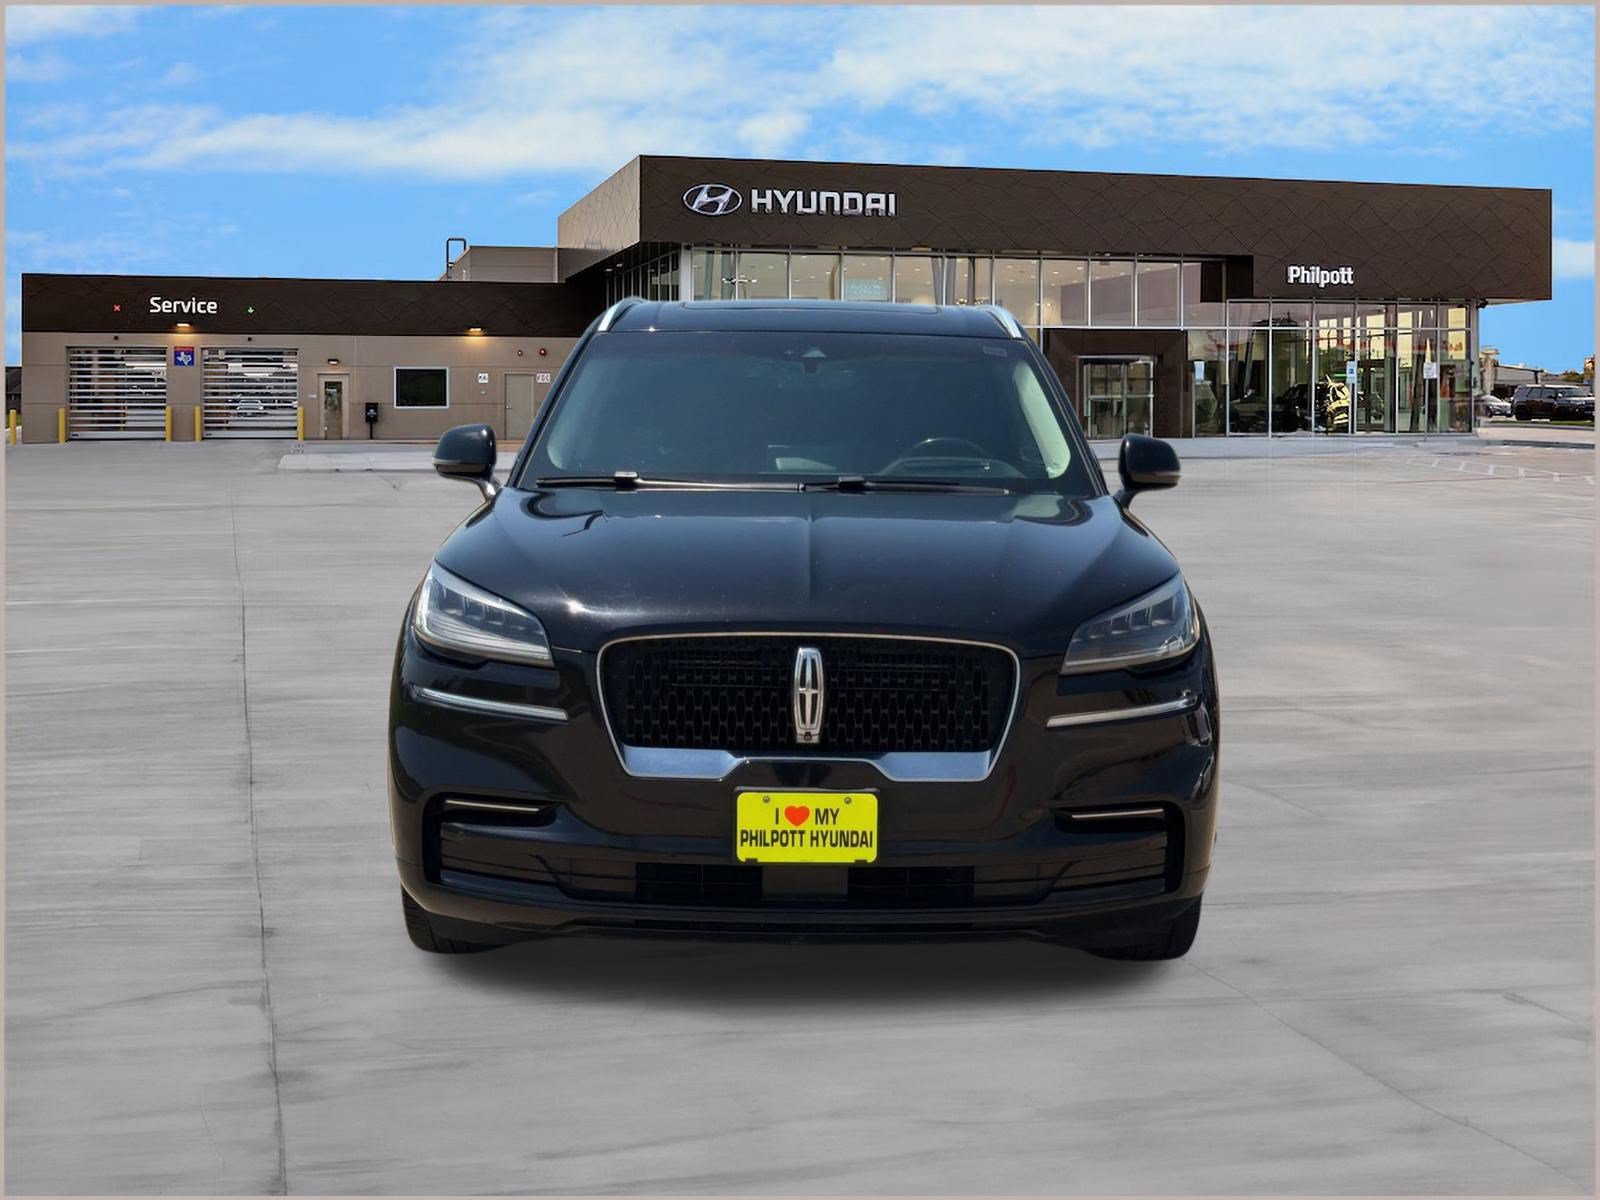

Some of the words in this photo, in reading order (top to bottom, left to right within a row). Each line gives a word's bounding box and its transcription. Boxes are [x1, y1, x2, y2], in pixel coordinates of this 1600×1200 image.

[751, 189, 896, 216] HYUNDAI
[1287, 265, 1354, 288] Philpott
[149, 296, 218, 314] Service
[775, 807, 780, 825] I
[815, 808, 840, 825] MY
[740, 829, 806, 847] PHILPOTT
[810, 830, 873, 848] HYUNDAI
